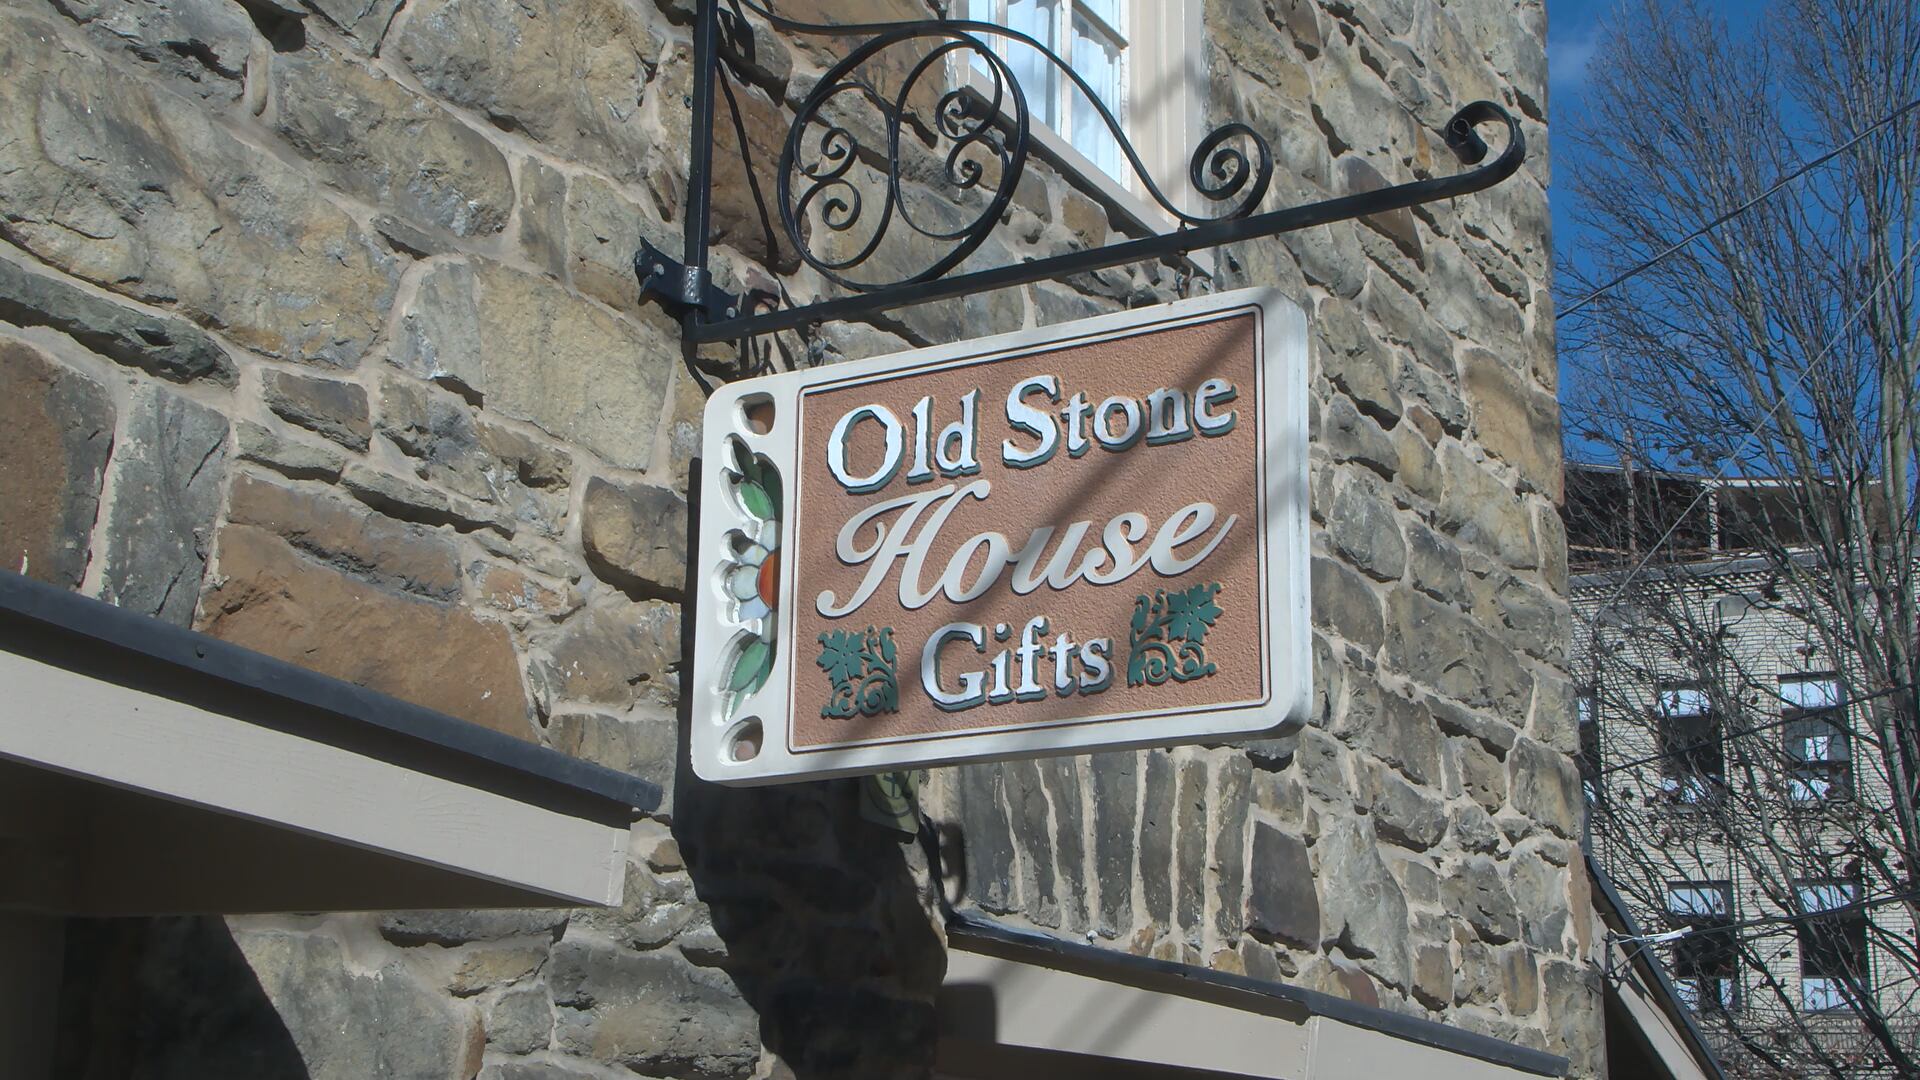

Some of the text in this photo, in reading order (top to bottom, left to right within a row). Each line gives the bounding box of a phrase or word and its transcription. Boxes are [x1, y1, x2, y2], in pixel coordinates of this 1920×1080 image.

[827, 375, 1239, 493] Old Stone
[815, 479, 1238, 618] House
[920, 617, 1114, 712] Gifts
